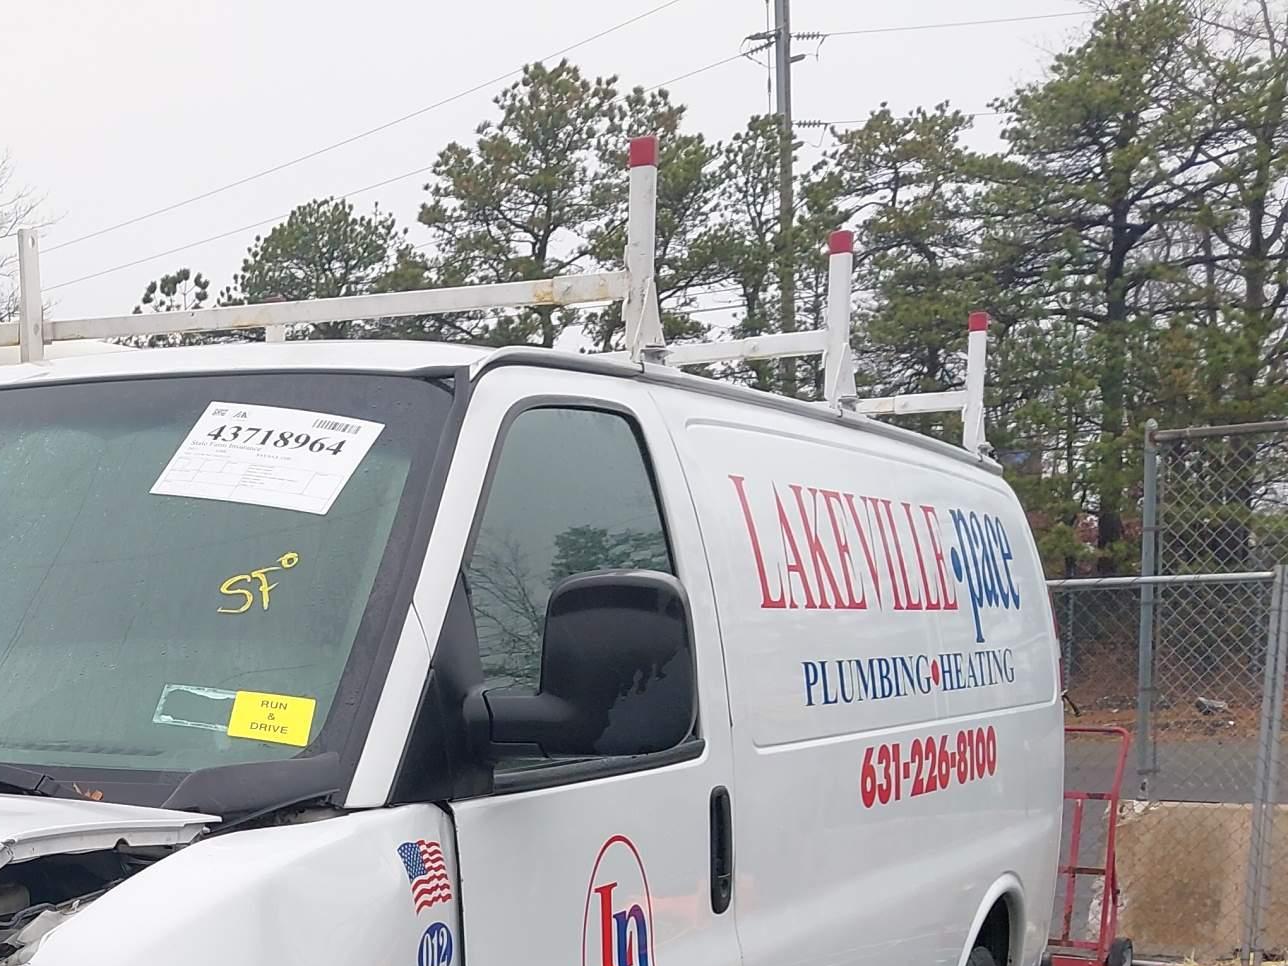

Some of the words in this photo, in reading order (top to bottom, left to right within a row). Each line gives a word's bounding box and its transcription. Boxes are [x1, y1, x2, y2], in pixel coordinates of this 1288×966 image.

[207, 424, 346, 455] 43718964
[728, 474, 959, 611] LAKEVILLE
[801, 654, 931, 706] PLUMBING
[938, 649, 1014, 691] HEATING
[261, 700, 288, 710] RUN
[267, 712, 275, 721] &
[249, 721, 289, 735] DRIVE
[861, 726, 997, 808] 631-226-8100
